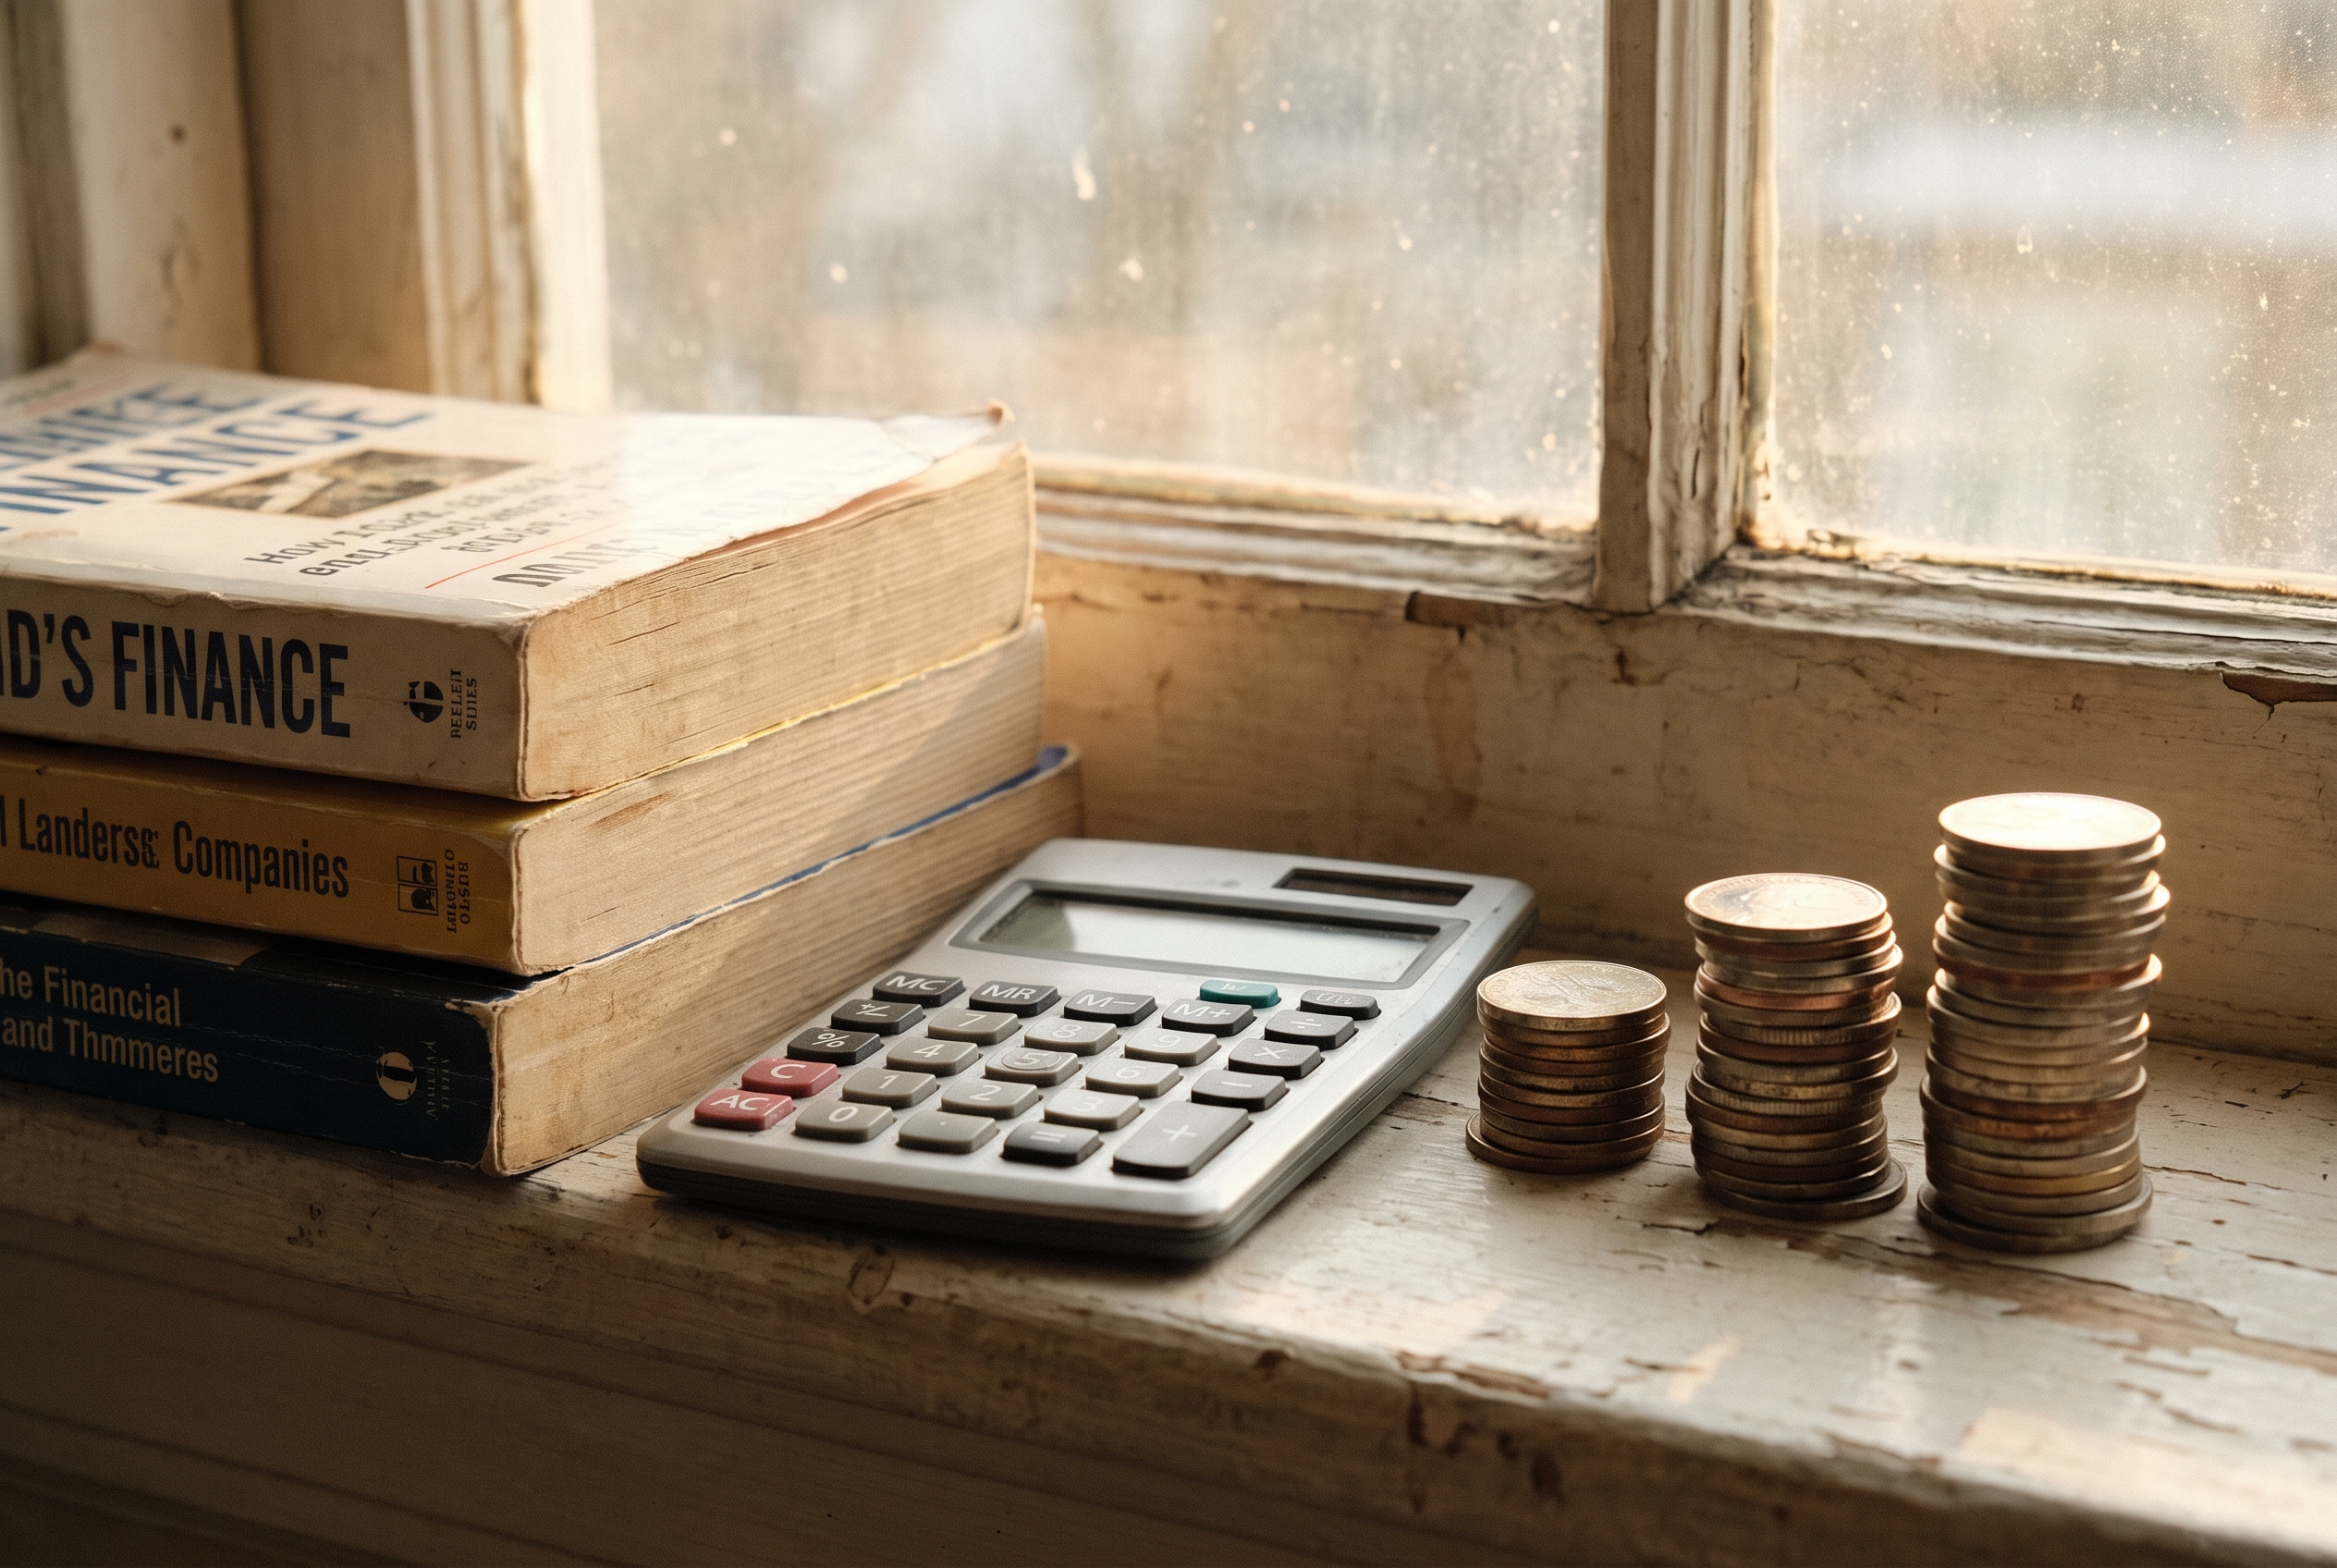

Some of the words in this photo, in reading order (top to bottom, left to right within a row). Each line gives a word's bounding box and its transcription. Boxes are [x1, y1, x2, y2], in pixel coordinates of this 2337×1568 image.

[0, 398, 434, 532] INANCE
[0, 608, 93, 707] D’S
[112, 620, 351, 738] FINANCE
[173, 820, 349, 898] Companies
[885, 974, 947, 991] MC
[44, 965, 180, 1027] Financial
[980, 984, 1037, 999] MR
[1172, 1003, 1231, 1019] M+
[957, 1013, 988, 1027] 7
[1051, 1024, 1083, 1039] 8
[812, 1033, 850, 1047] %
[1152, 1035, 1182, 1047] 9
[3, 1017, 53, 1053] and
[64, 1018, 218, 1083] Thmmeres
[912, 1044, 945, 1059] 4
[1013, 1052, 1046, 1066] 5
[770, 1064, 807, 1079] C
[1115, 1065, 1146, 1079] 6
[878, 1074, 899, 1089] 1
[970, 1084, 1001, 1101] 2
[710, 1095, 769, 1110] AC
[1072, 1096, 1105, 1111] 3
[828, 1106, 859, 1122] 0
